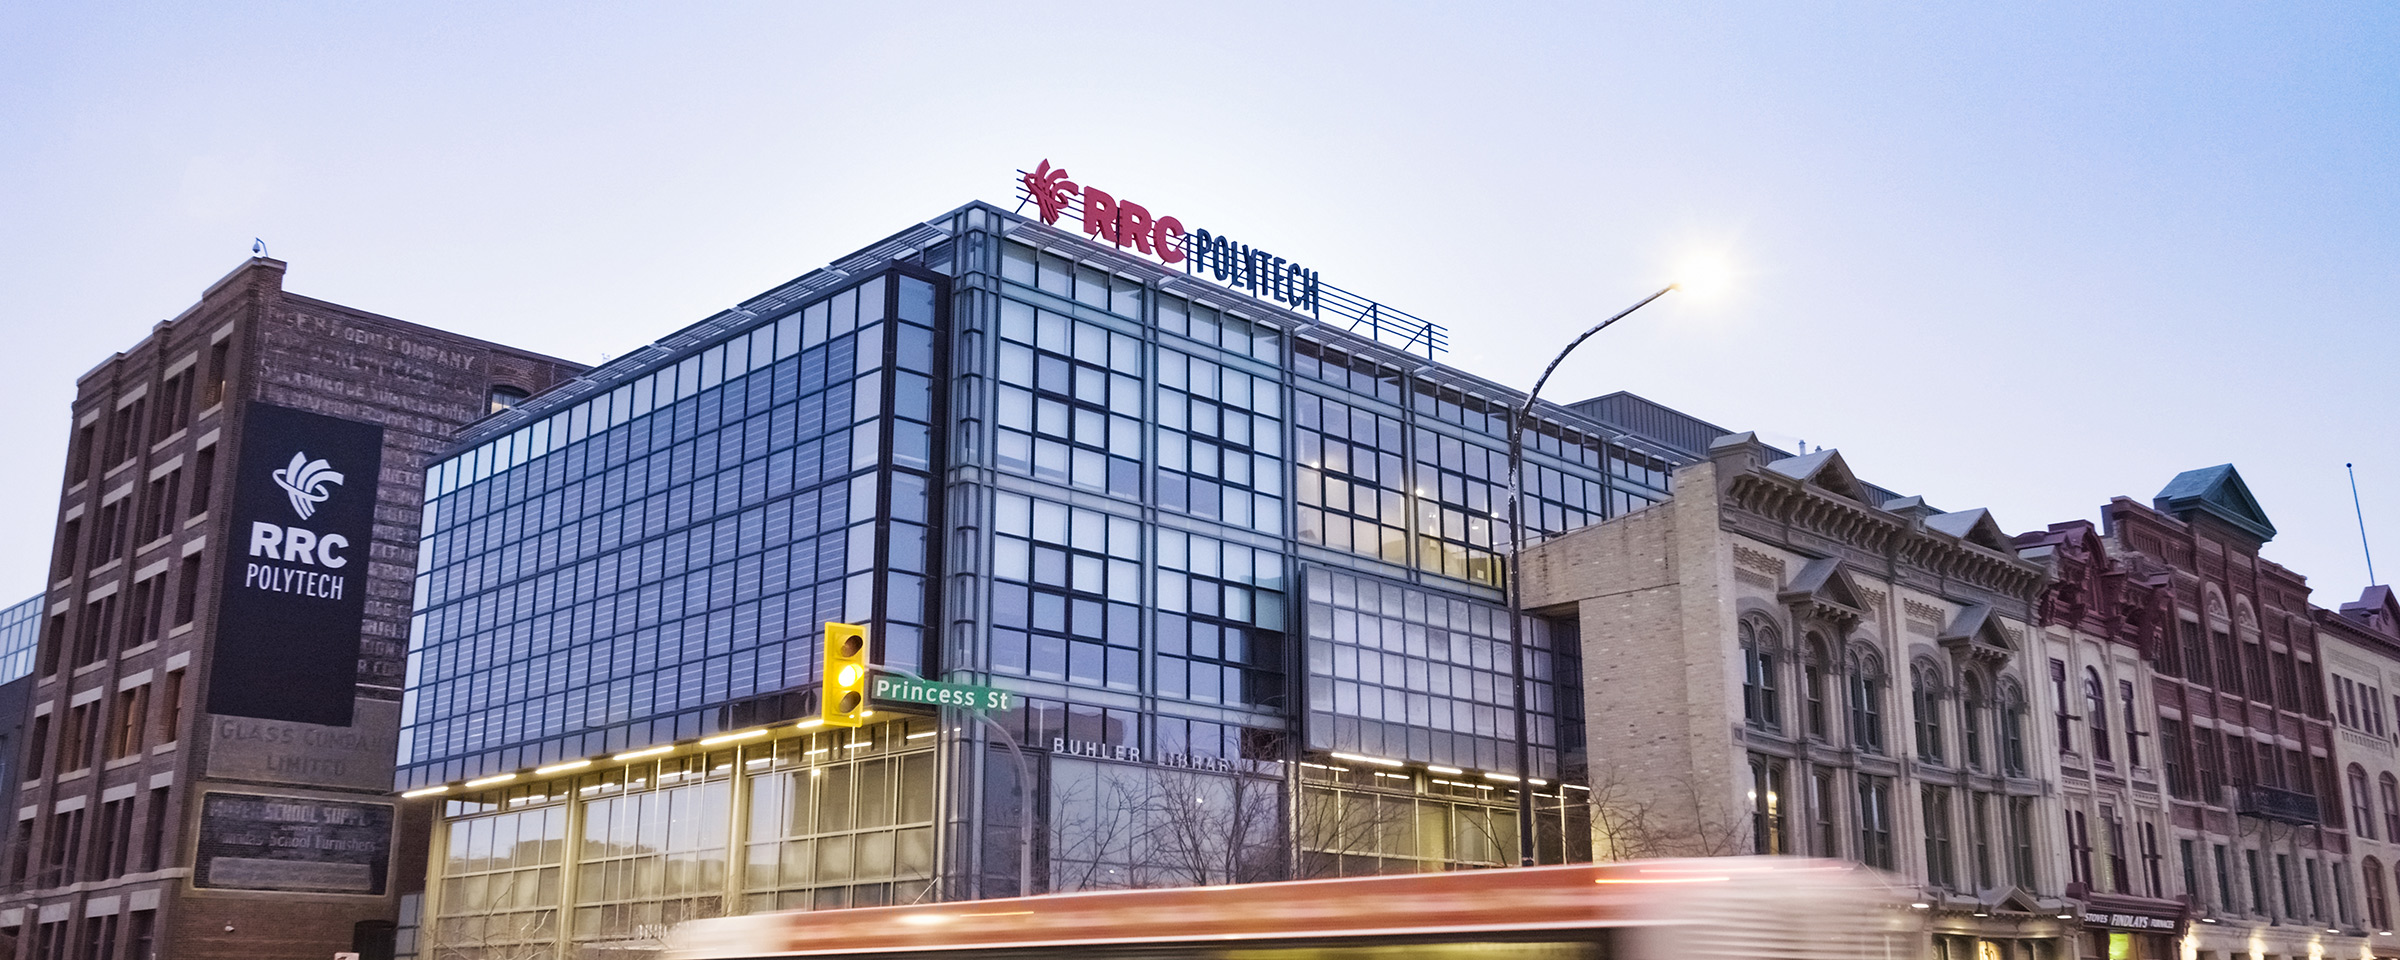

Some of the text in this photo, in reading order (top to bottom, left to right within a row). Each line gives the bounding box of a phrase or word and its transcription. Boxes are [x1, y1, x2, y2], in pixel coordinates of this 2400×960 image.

[1083, 185, 1319, 314] RRC POLYTECH
[249, 521, 350, 569] RRC
[245, 563, 344, 600] POLYTECH
[876, 679, 1008, 710] Princess St
[221, 720, 295, 744] GLASS
[1053, 737, 1141, 763] BUHLER
[264, 803, 319, 823] SCHOOL
[323, 807, 370, 827] SUPPL
[268, 832, 310, 849] School
[315, 834, 376, 852] Furnishers
[2084, 913, 2108, 923] STOVES
[2111, 914, 2149, 928] FINDLAYS
